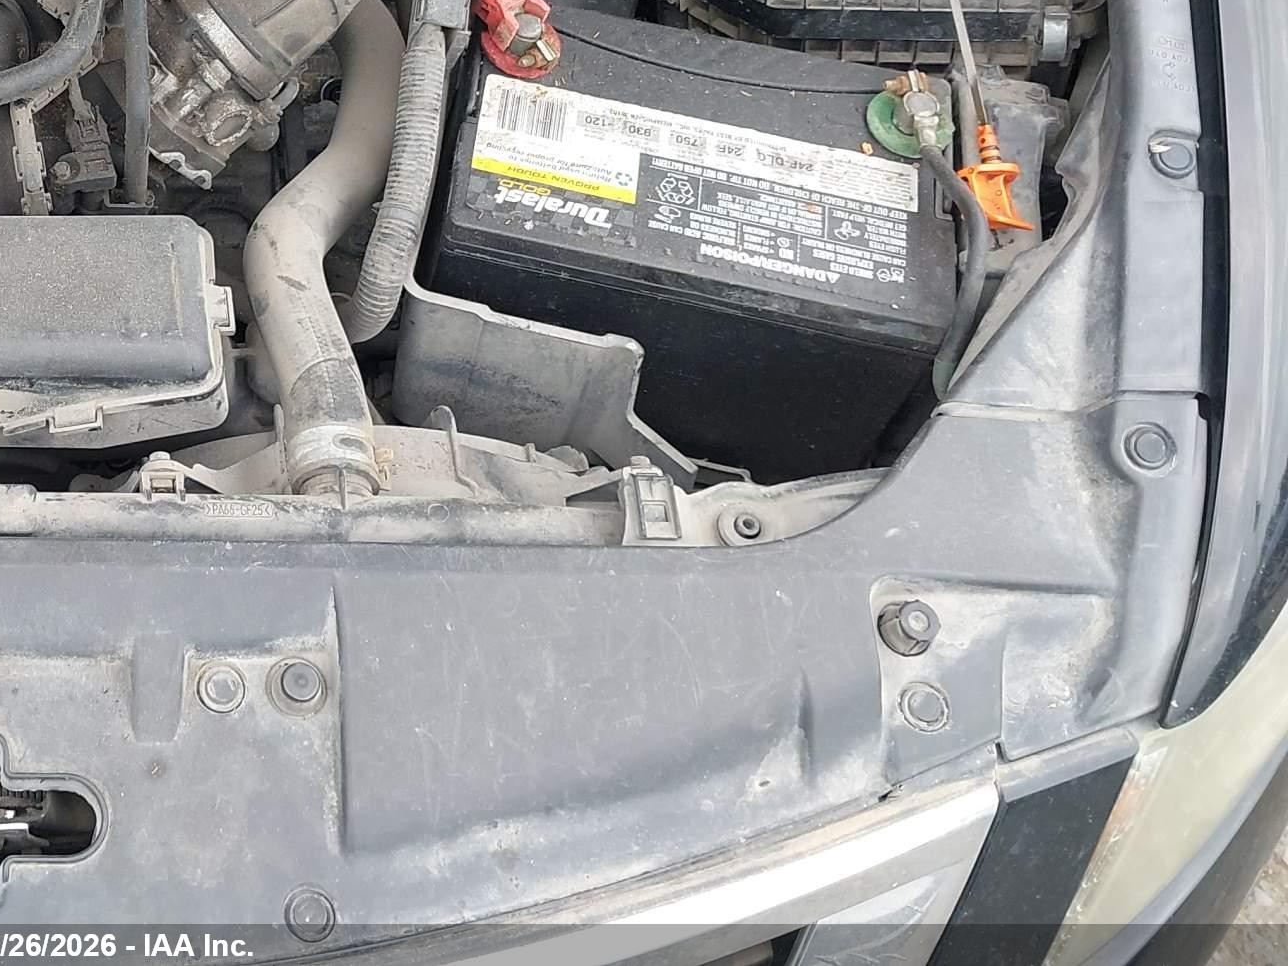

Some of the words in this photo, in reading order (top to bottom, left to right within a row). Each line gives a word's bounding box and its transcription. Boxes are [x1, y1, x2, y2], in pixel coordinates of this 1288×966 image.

[674, 134, 698, 147] 750
[716, 143, 742, 157] 24F
[506, 165, 546, 179] TOUGH
[498, 177, 551, 196] GOLD
[550, 174, 600, 191] PROVEN
[742, 177, 757, 186] NOT
[758, 180, 770, 189] DO
[810, 192, 820, 200] OF
[821, 194, 845, 206] REACH
[492, 184, 614, 228] Duralast
[845, 199, 860, 209] THE
[861, 203, 872, 212] OF
[872, 205, 888, 215] OUT
[888, 209, 907, 219] KEEP
[699, 246, 826, 280] DANGER/POISON
